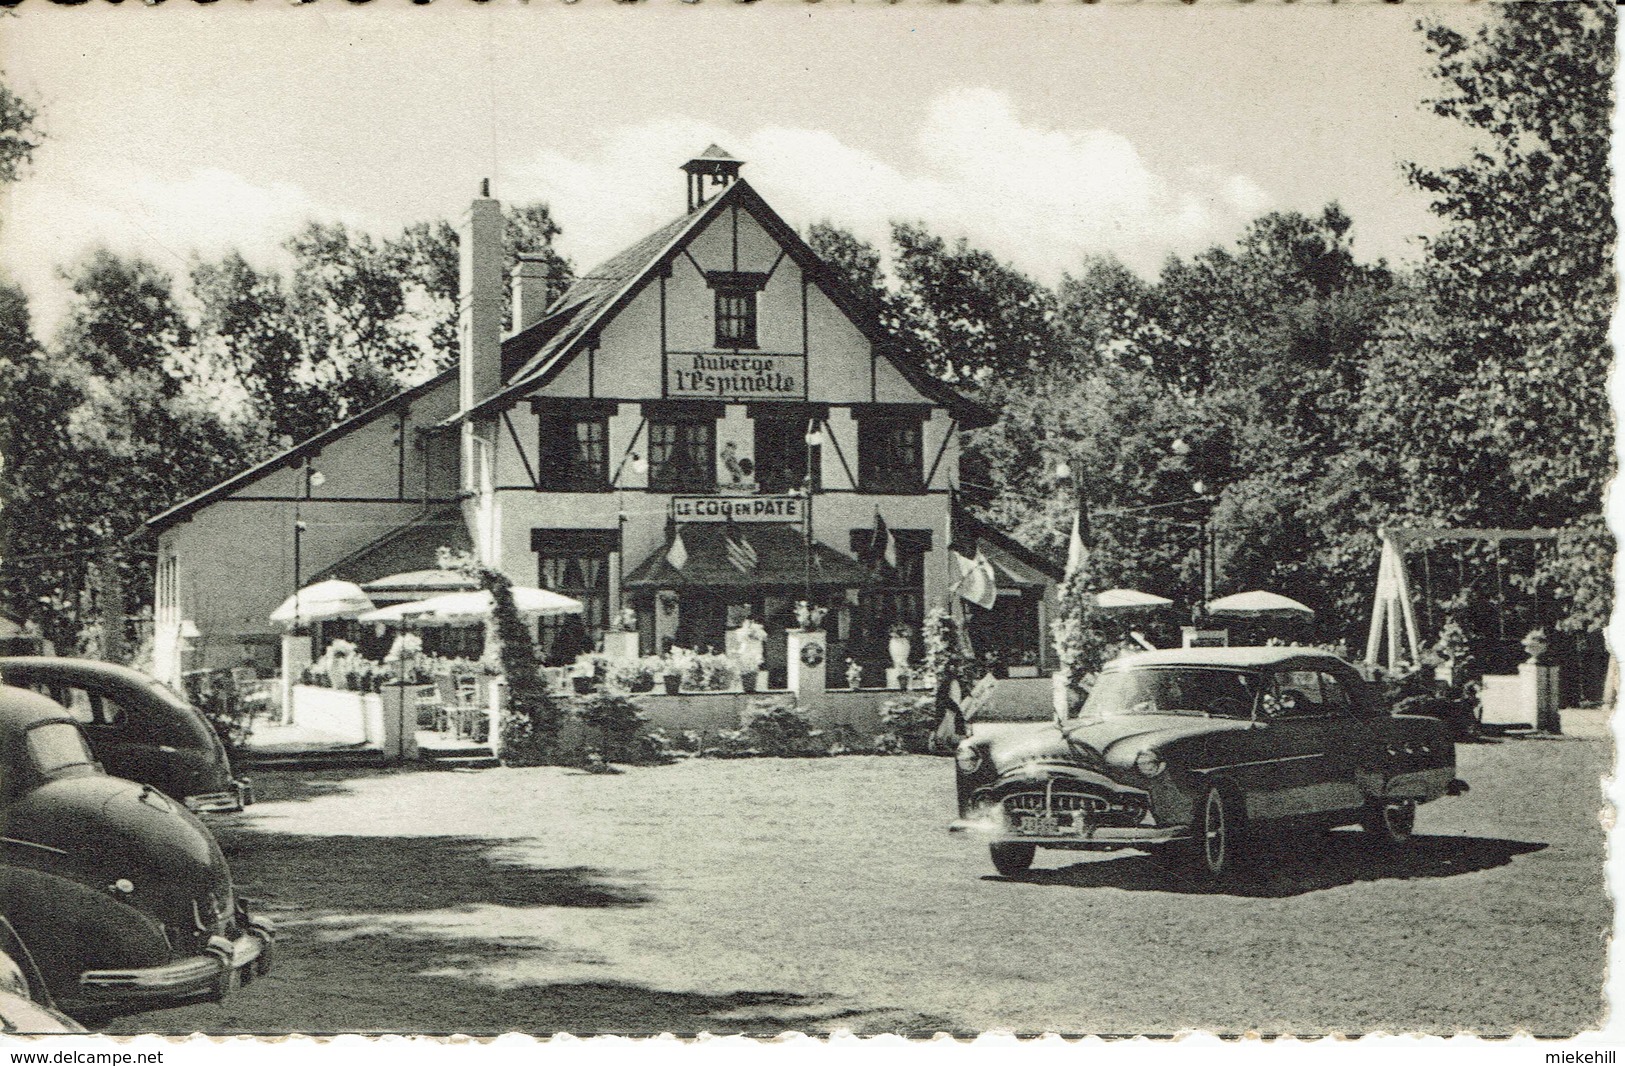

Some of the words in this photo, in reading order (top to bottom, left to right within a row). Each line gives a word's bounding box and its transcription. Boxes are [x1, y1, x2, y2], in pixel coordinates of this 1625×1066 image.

[693, 355, 773, 376] Auberge
[677, 503, 691, 516] LE
[696, 501, 733, 517] COQ
[736, 503, 751, 516] EN
